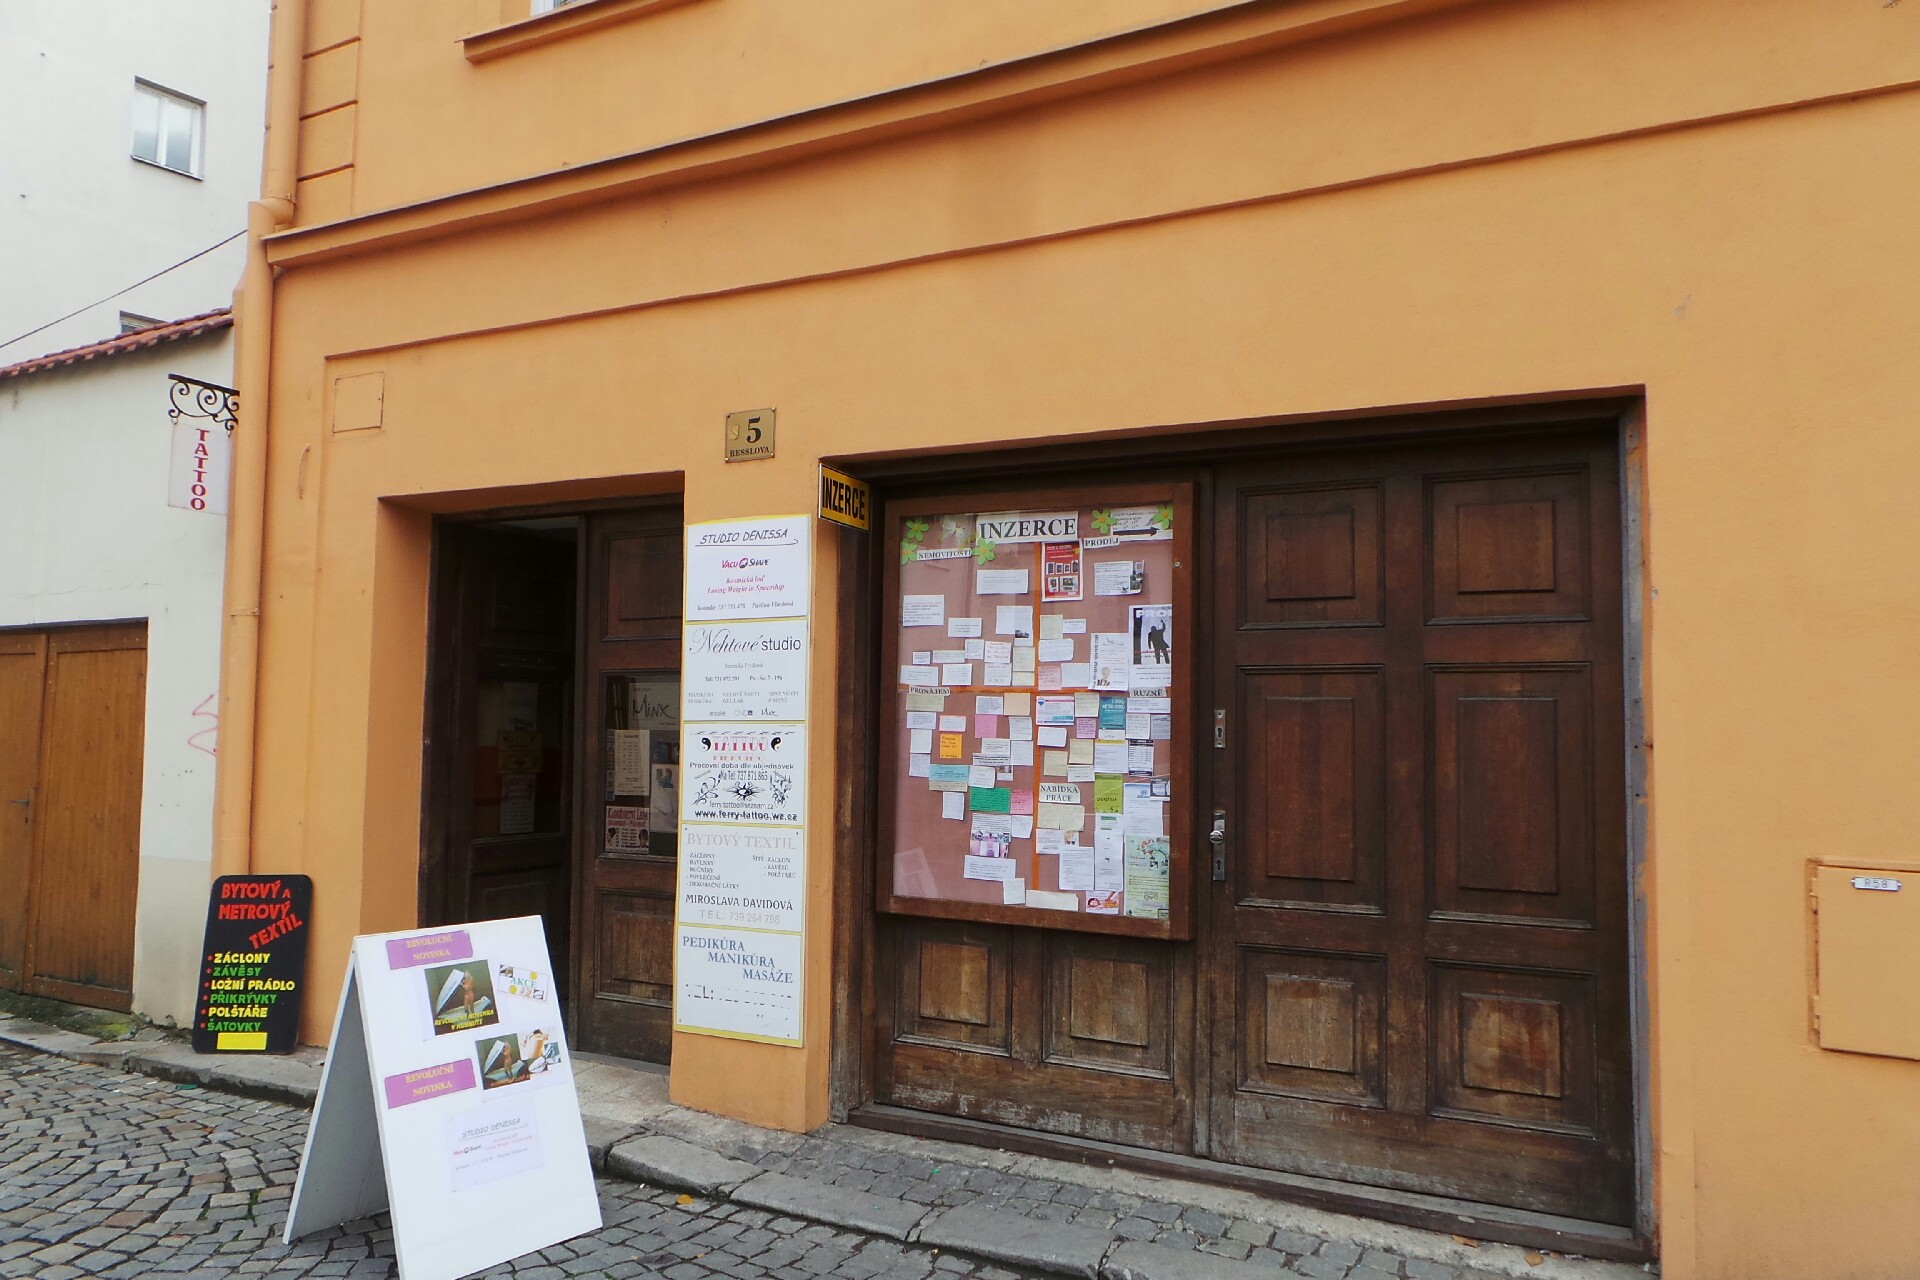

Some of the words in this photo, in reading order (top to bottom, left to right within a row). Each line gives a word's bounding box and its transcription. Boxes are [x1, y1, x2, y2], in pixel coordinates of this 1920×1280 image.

[746, 416, 763, 444] 5
[729, 446, 770, 458] RESSLOVA
[190, 428, 210, 511] TATTOO
[822, 475, 866, 521] INZERCE
[700, 533, 740, 544] STUDIO
[743, 528, 789, 542] DENISSA
[979, 519, 1076, 539] INZERCE
[1085, 538, 1119, 547] PRODEJ
[918, 550, 971, 559] NEMOVITOSTI
[689, 627, 764, 654] Nehtové
[761, 636, 802, 651] studio
[1041, 784, 1079, 794] NABÍDKA
[1046, 794, 1074, 802] PRÁCE
[687, 832, 741, 846] BYTOVÝ
[744, 835, 797, 849] TEXTIL
[221, 880, 282, 899] BYTOVÝ
[685, 894, 740, 907] MIROSLAVA
[743, 897, 794, 910] DAVIDOVÁ
[218, 900, 291, 920] METROVÝ
[729, 911, 744, 921] 739
[765, 914, 780, 924] 798
[248, 913, 304, 950] TEXTIL
[682, 936, 746, 952] PEDIKÚRA
[213, 951, 271, 964] ZÁCLONY
[413, 949, 451, 961] NOVINKA
[708, 952, 775, 968] MANIKÚRA
[212, 965, 262, 977] ZÁVĚSY
[742, 968, 794, 983] MASÁŽE
[211, 978, 244, 991] LOŽNÍ
[248, 978, 296, 991] PRÁDLO
[510, 977, 537, 989] AKCE
[209, 991, 278, 1004] PŘIKRÝVKY
[208, 1005, 268, 1018] POLŠTÁŘE
[207, 1019, 262, 1032] ŠATOVKY
[413, 1081, 453, 1097] NOVINKA
[462, 1126, 489, 1139] STUDIO
[491, 1118, 521, 1131] DENISSA
